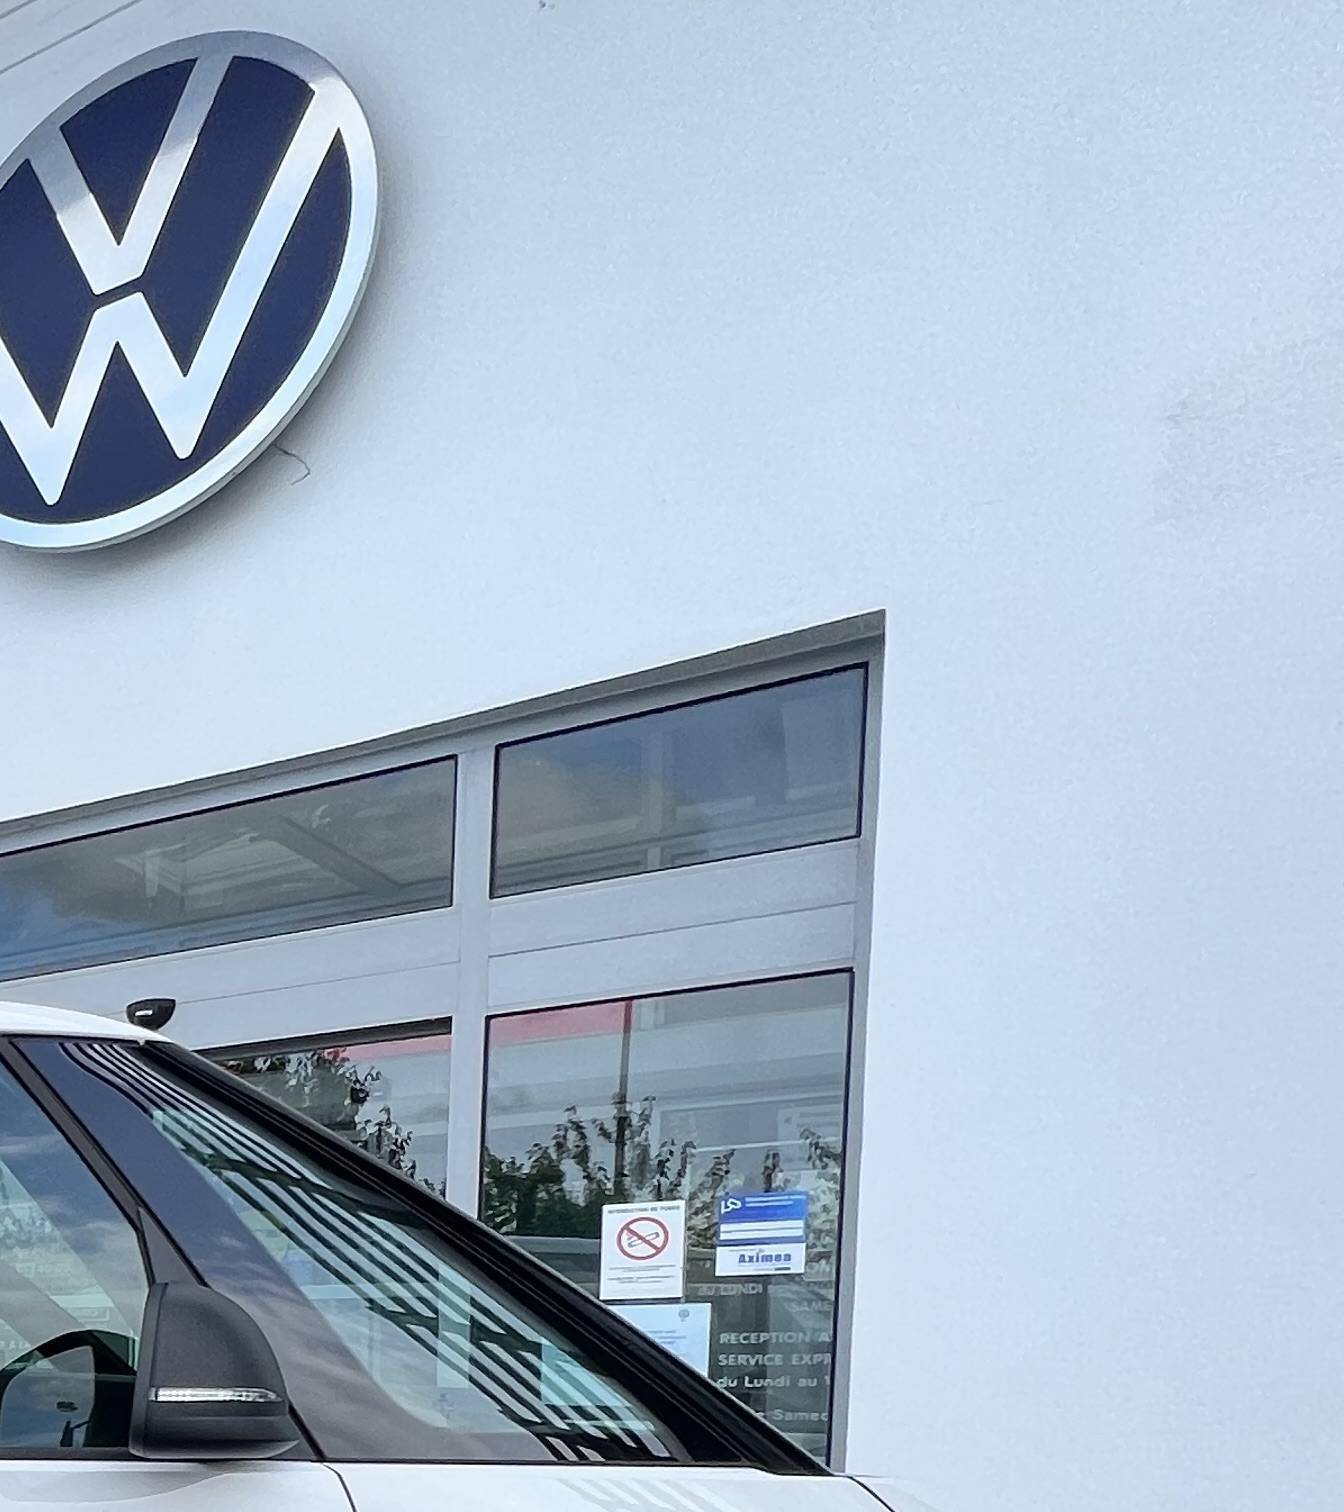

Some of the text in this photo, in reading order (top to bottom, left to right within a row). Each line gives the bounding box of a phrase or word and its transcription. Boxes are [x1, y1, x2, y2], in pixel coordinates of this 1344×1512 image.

[719, 1332, 810, 1344] RECEPTION
[718, 1354, 784, 1366] SERVICE
[744, 1376, 790, 1388] Lundi
[798, 1378, 817, 1387] au
